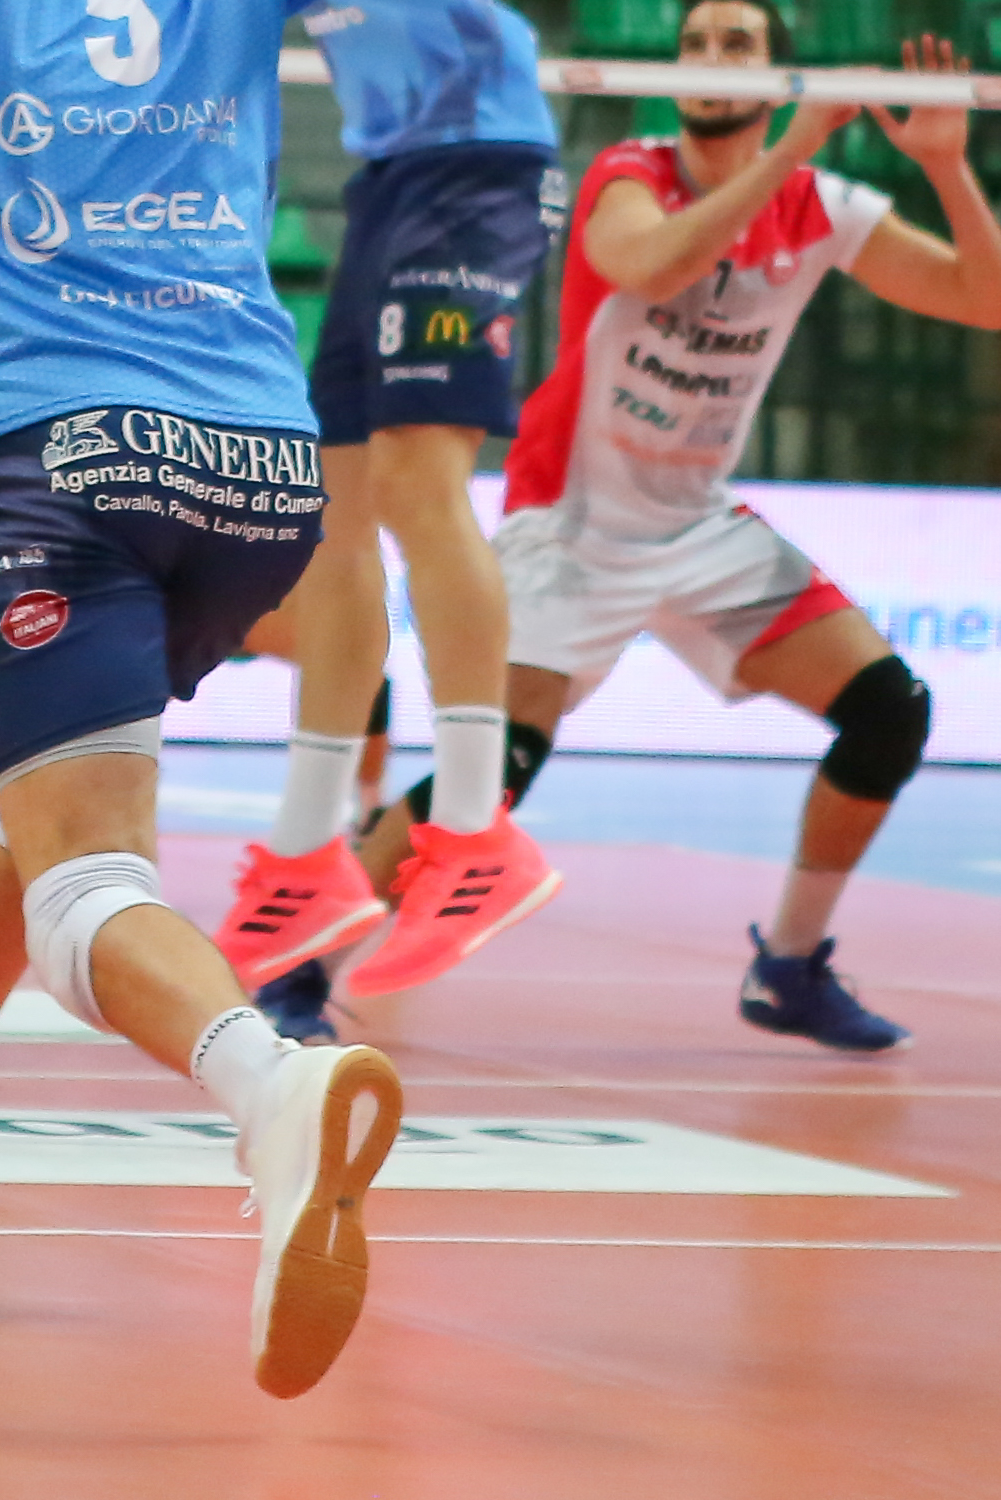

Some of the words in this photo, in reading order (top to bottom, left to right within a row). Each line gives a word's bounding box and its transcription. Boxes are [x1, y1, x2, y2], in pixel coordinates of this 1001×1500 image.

[82, 191, 247, 232] EGEA
[379, 302, 405, 357] 8
[121, 409, 320, 488] GENERALI
[50, 461, 151, 493] Agenzia
[157, 465, 246, 512] Generale
[251, 490, 272, 512] di
[275, 491, 324, 515] Cuneo
[94, 494, 165, 518] Cavallo,
[213, 517, 274, 543] Lavigna
